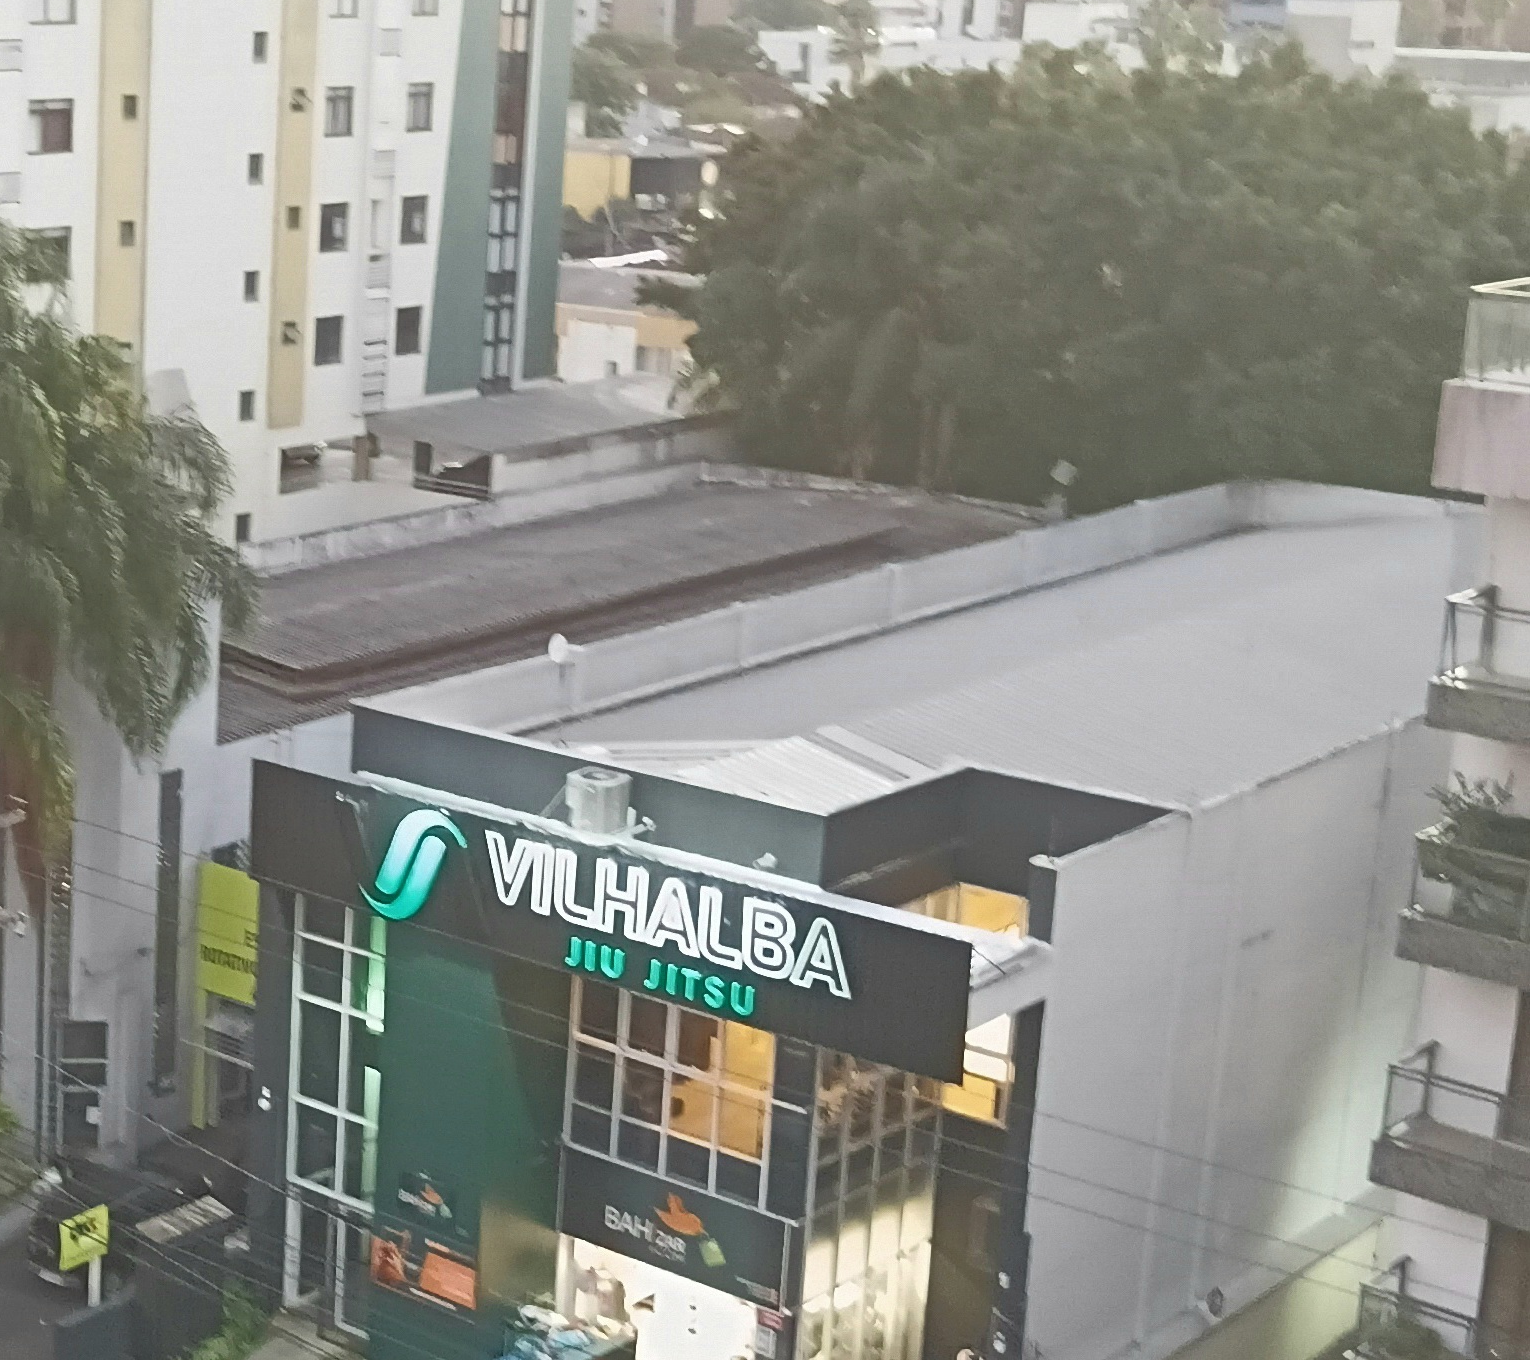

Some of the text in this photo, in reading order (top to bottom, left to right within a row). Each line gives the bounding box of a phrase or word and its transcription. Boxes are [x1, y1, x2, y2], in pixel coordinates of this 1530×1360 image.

[484, 829, 852, 1000] VILHALBA
[564, 936, 756, 1017] JIU JITSU
